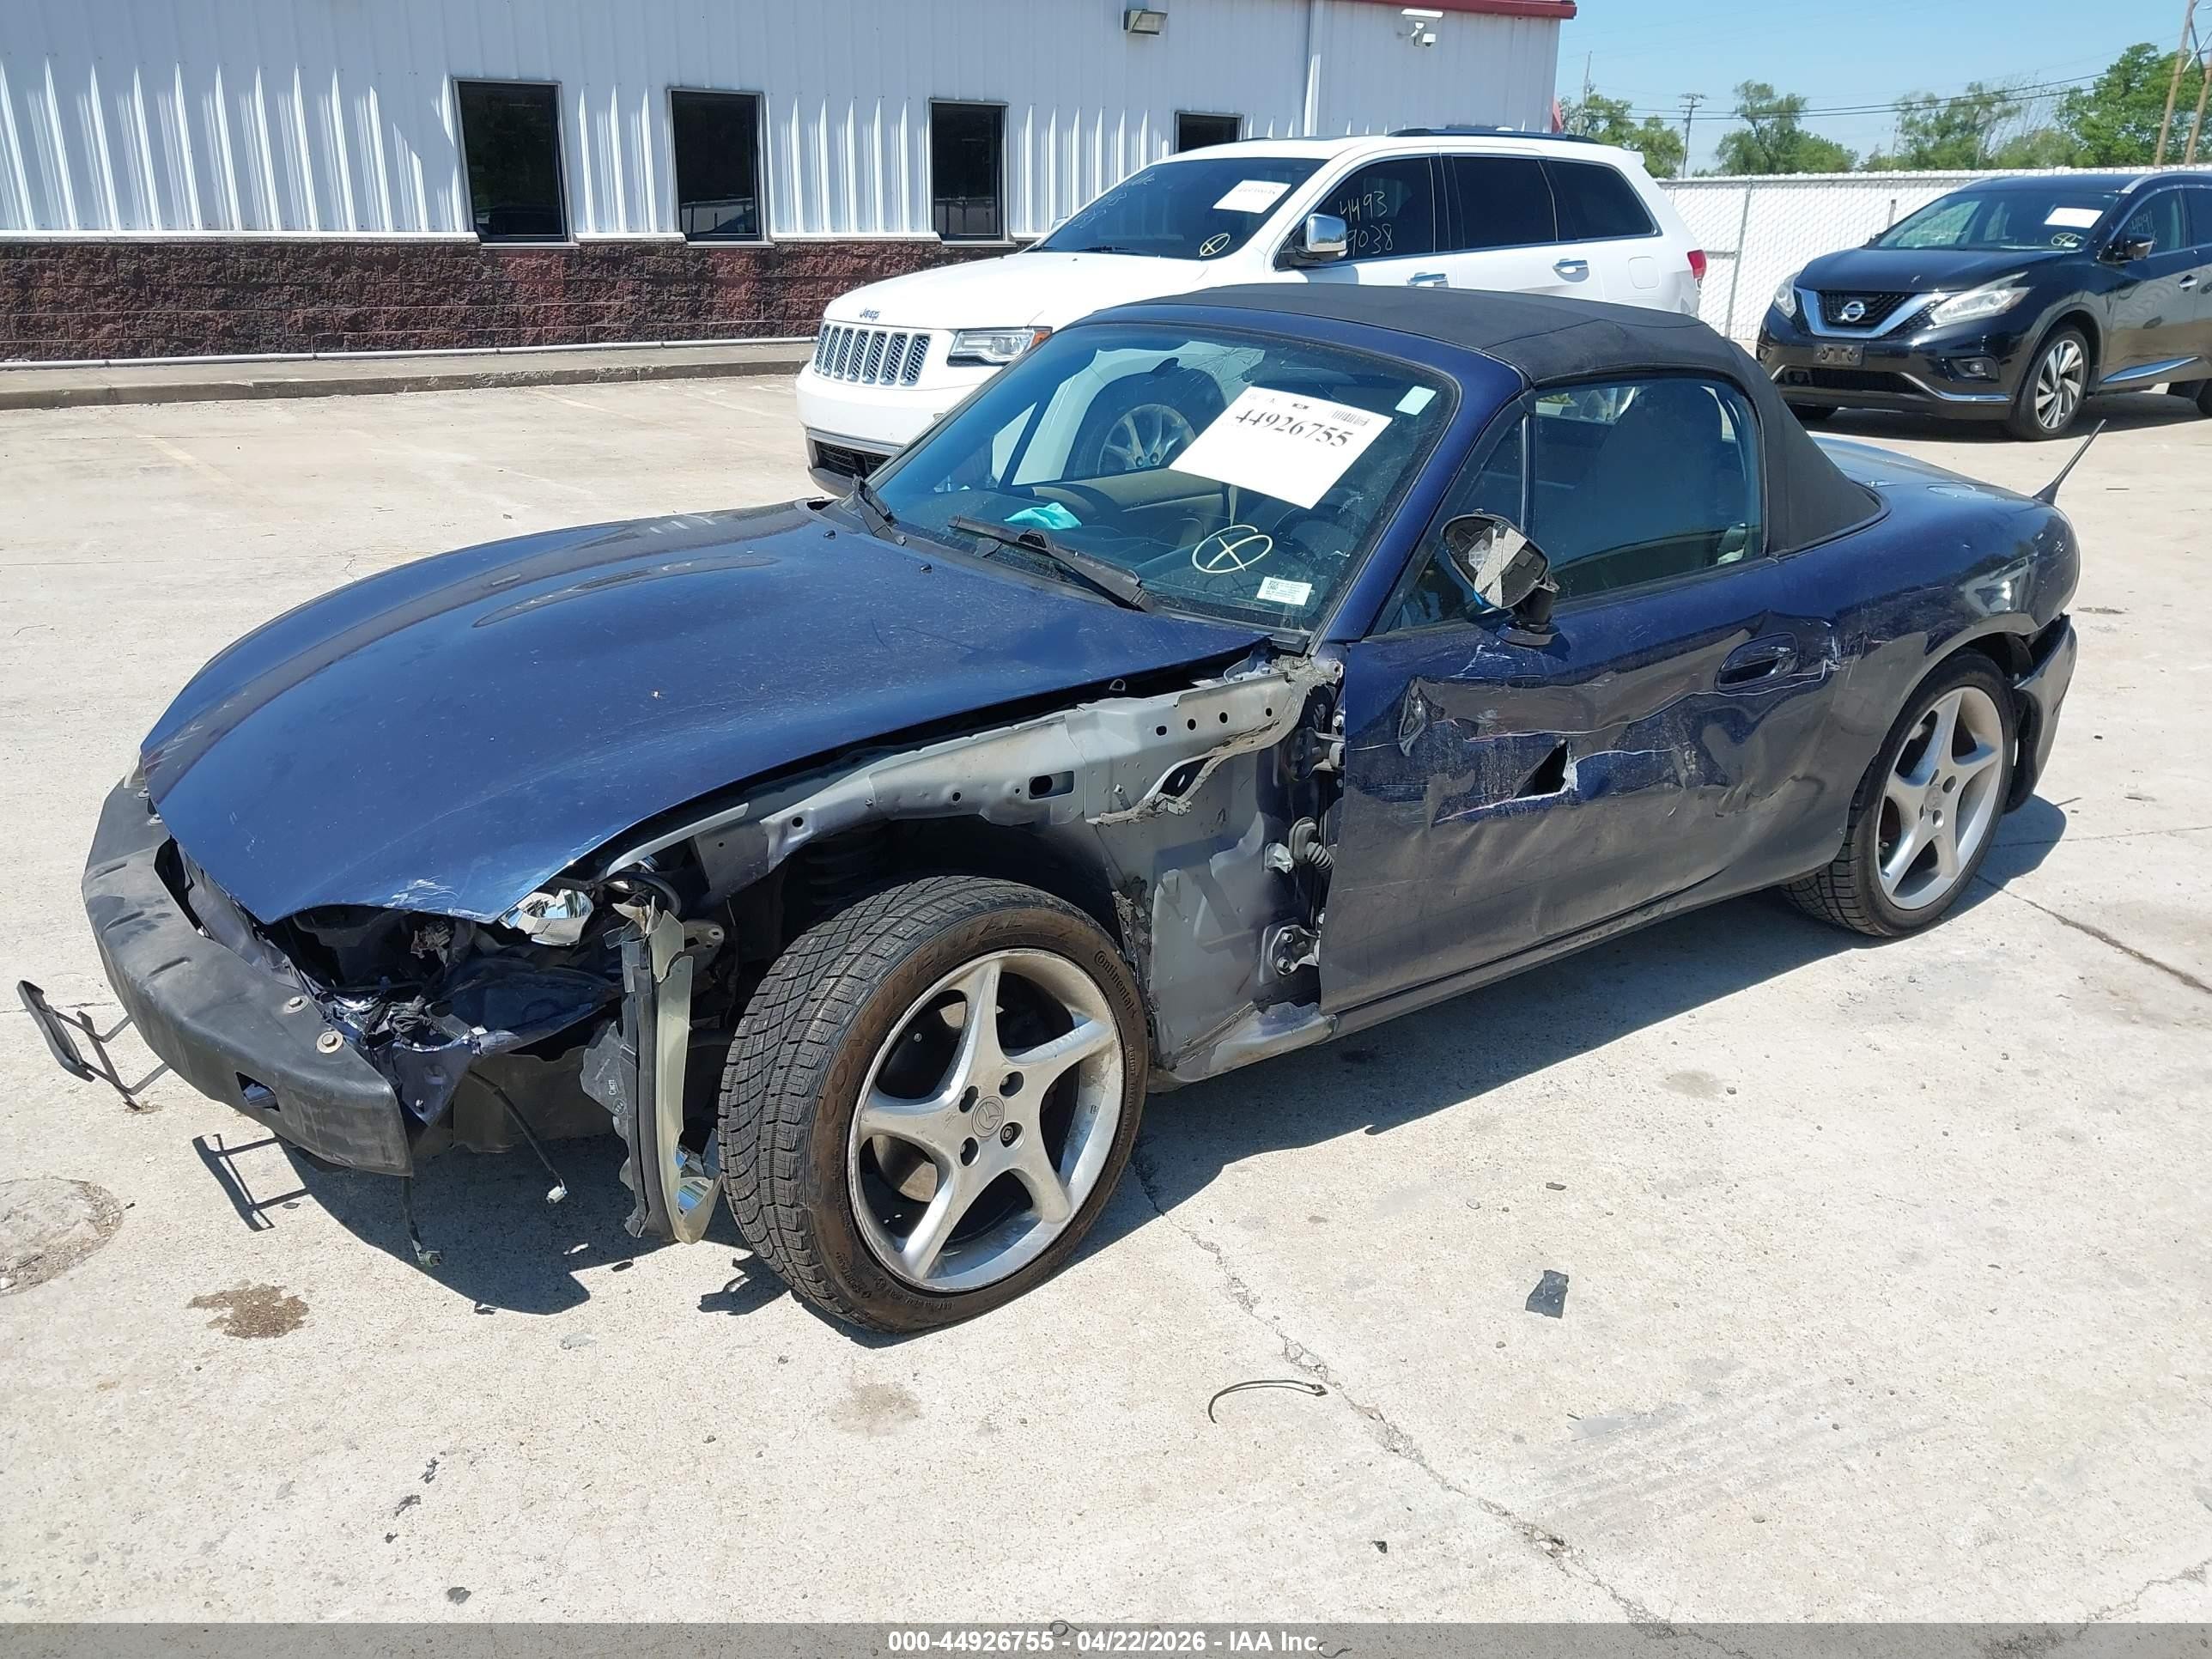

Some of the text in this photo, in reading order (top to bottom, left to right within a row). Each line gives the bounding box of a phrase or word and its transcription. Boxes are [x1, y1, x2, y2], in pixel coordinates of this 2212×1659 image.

[1339, 191, 1388, 223] 4493
[859, 307, 880, 322] Jeep
[1235, 408, 1354, 447] 44926755
[1094, 950, 1136, 1011] Continental
